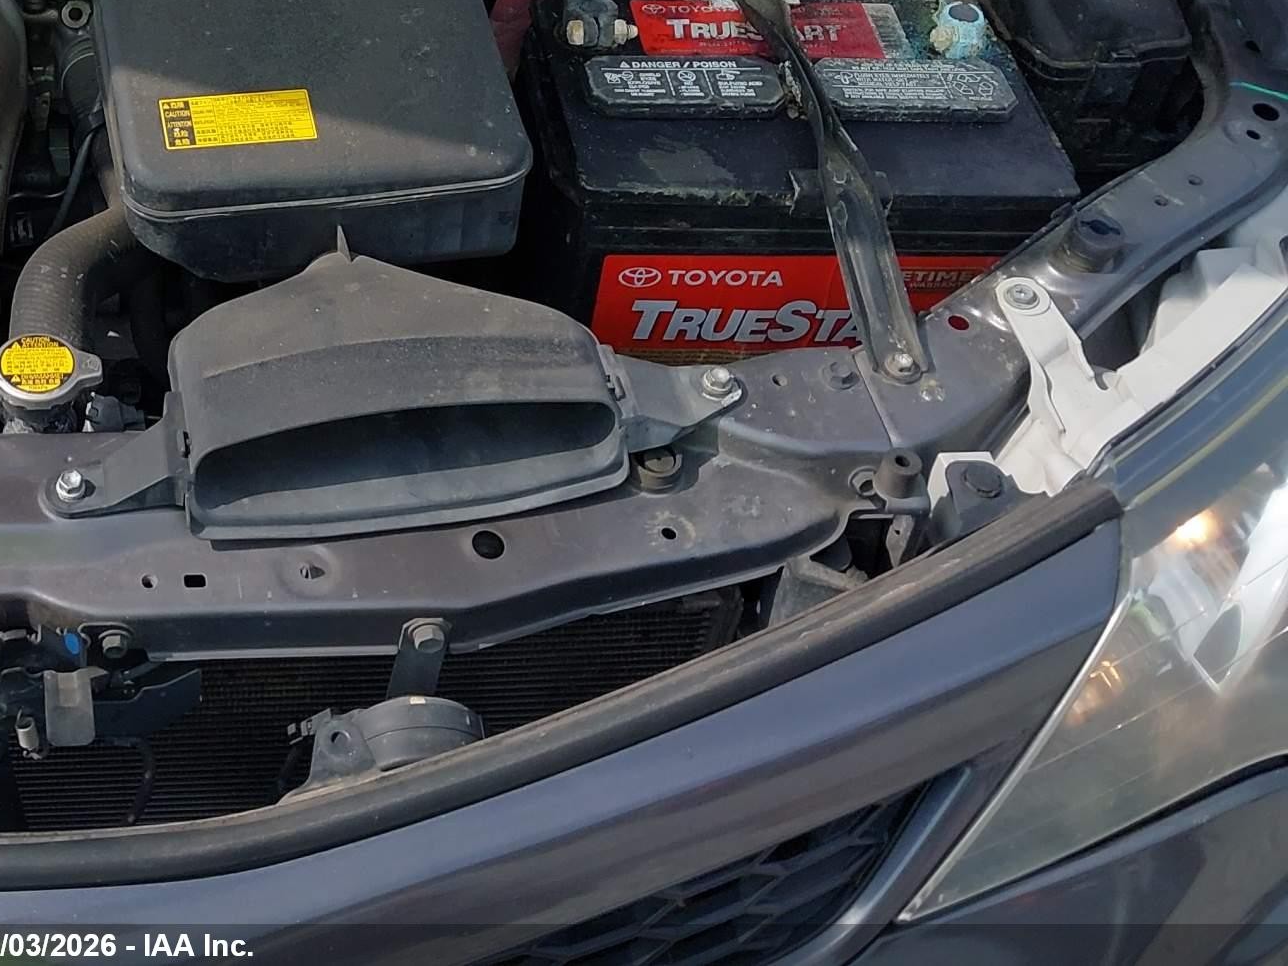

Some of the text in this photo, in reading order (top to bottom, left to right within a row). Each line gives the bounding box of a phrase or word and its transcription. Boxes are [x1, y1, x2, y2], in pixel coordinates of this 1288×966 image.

[631, 61, 681, 69] DANGER
[692, 61, 737, 69] POISON
[165, 109, 191, 118] CAUTION
[668, 270, 783, 286] TOYOTA
[631, 299, 865, 343] TRUESTA
